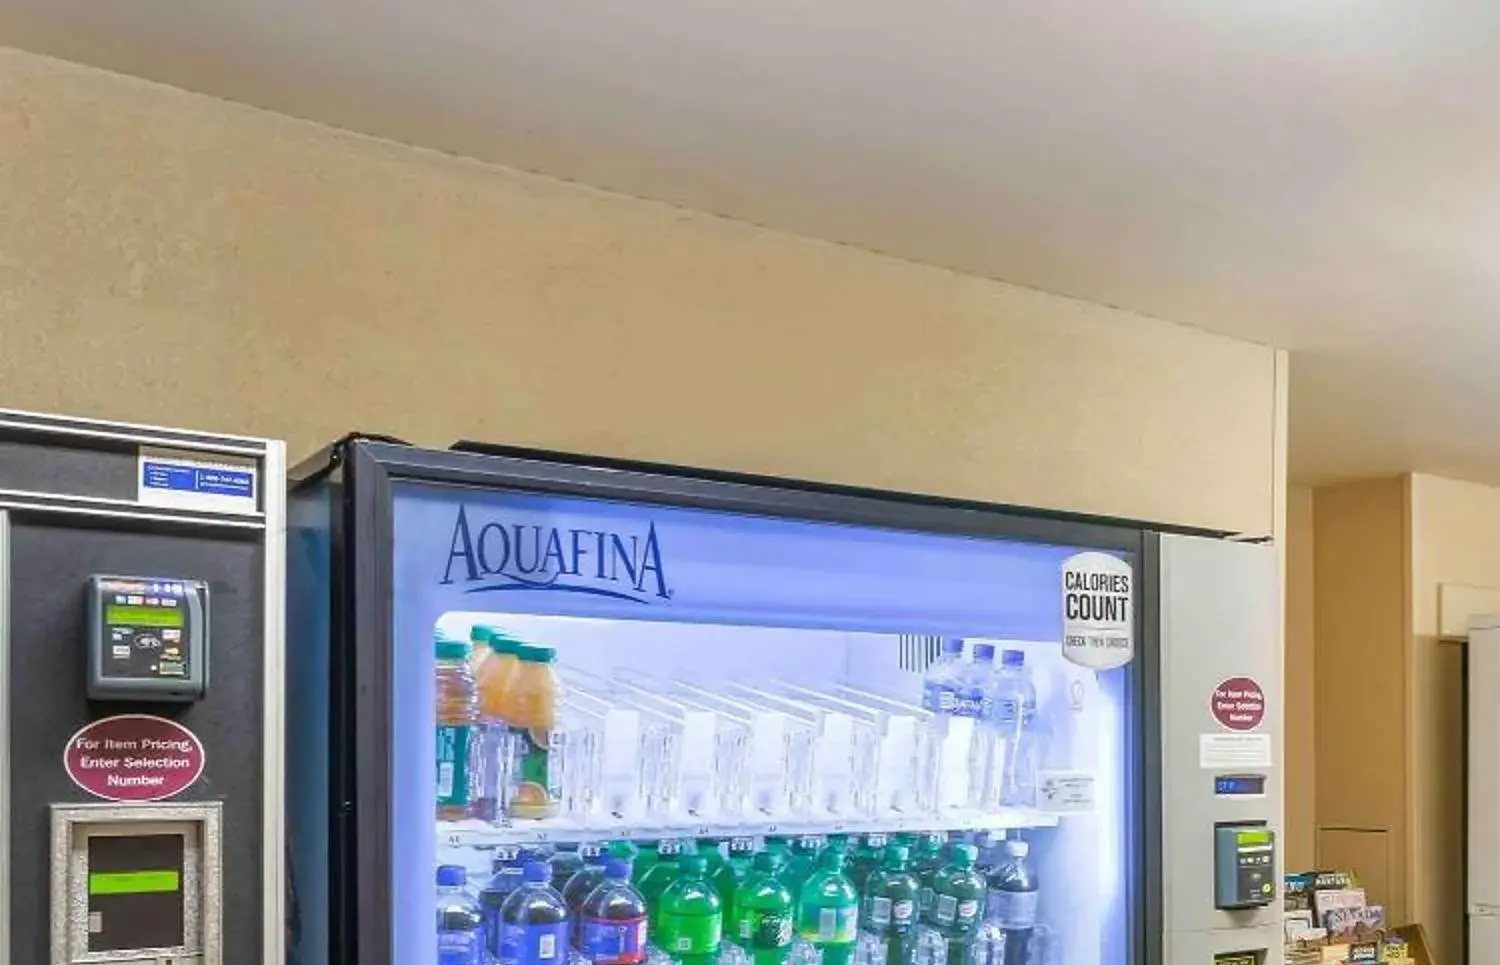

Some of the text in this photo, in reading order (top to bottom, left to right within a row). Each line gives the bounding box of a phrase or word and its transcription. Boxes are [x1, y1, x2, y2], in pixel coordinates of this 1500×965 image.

[440, 503, 671, 601] AQUAFINA
[1065, 571, 1129, 593] CALORIES
[1066, 593, 1129, 622] COUNT
[76, 737, 100, 750] For
[105, 738, 137, 750] Item
[80, 756, 190, 769] Enter Selection
[107, 774, 164, 787] Number
